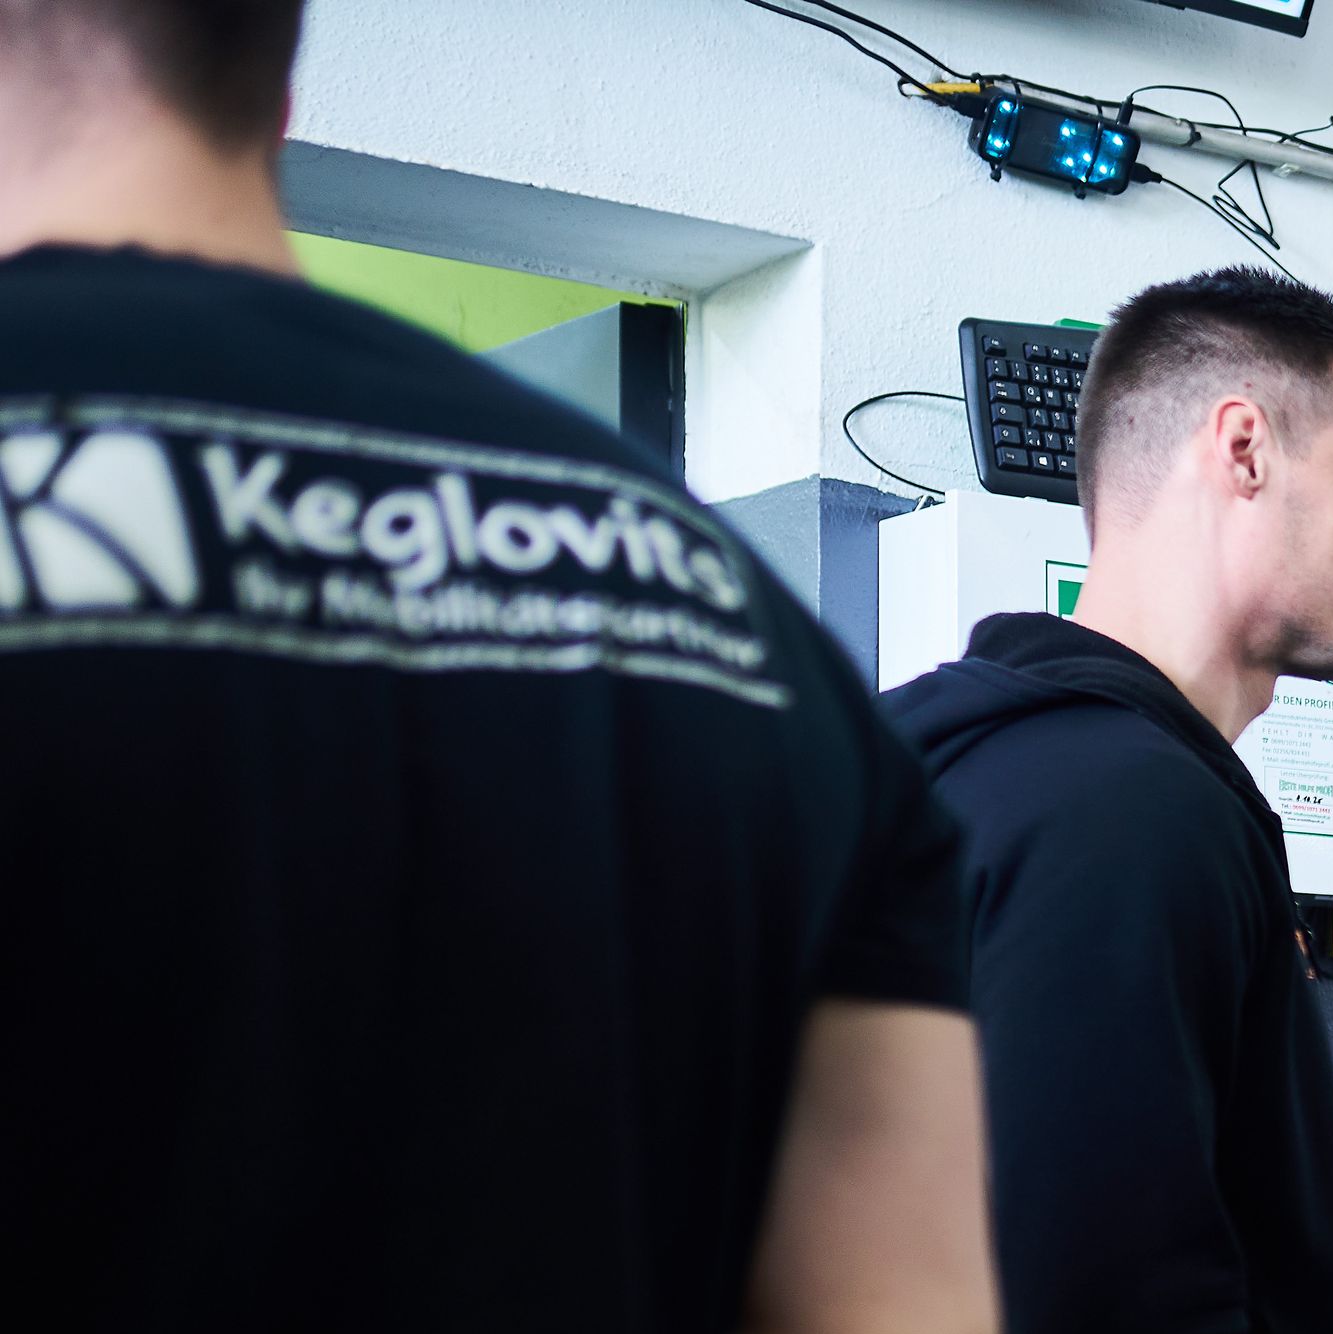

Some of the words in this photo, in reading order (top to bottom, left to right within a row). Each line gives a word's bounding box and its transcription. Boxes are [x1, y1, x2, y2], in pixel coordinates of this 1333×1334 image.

[200, 440, 750, 612] Keglovits
[1283, 695, 1302, 706] DEN
[1298, 731, 1312, 739] DIR
